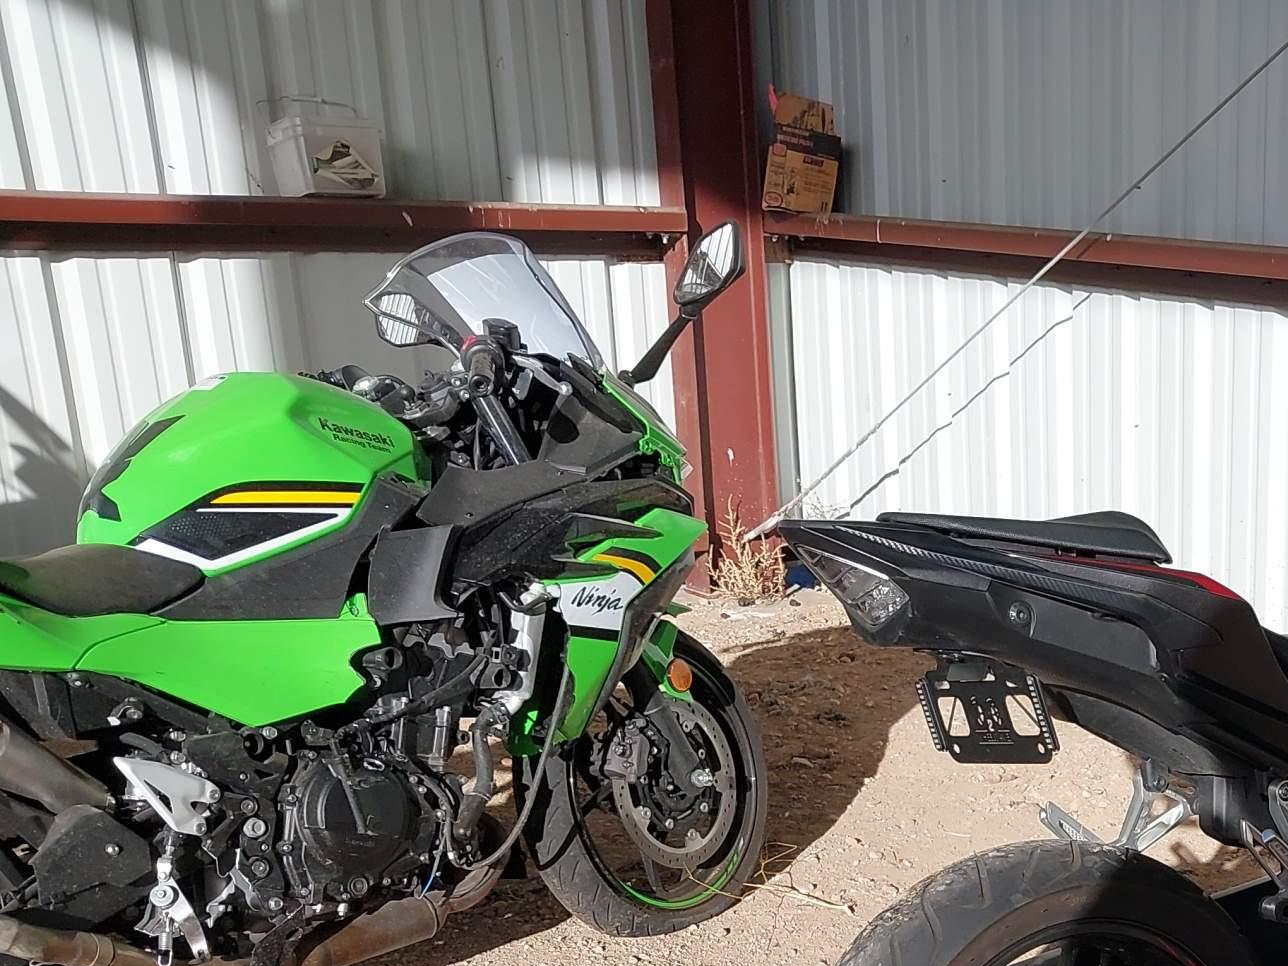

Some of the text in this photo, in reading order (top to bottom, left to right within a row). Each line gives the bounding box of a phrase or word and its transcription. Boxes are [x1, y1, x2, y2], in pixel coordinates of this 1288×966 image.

[317, 416, 395, 449] Kawasaki
[332, 433, 392, 454] Racing Team
[570, 586, 624, 615] Ninja
